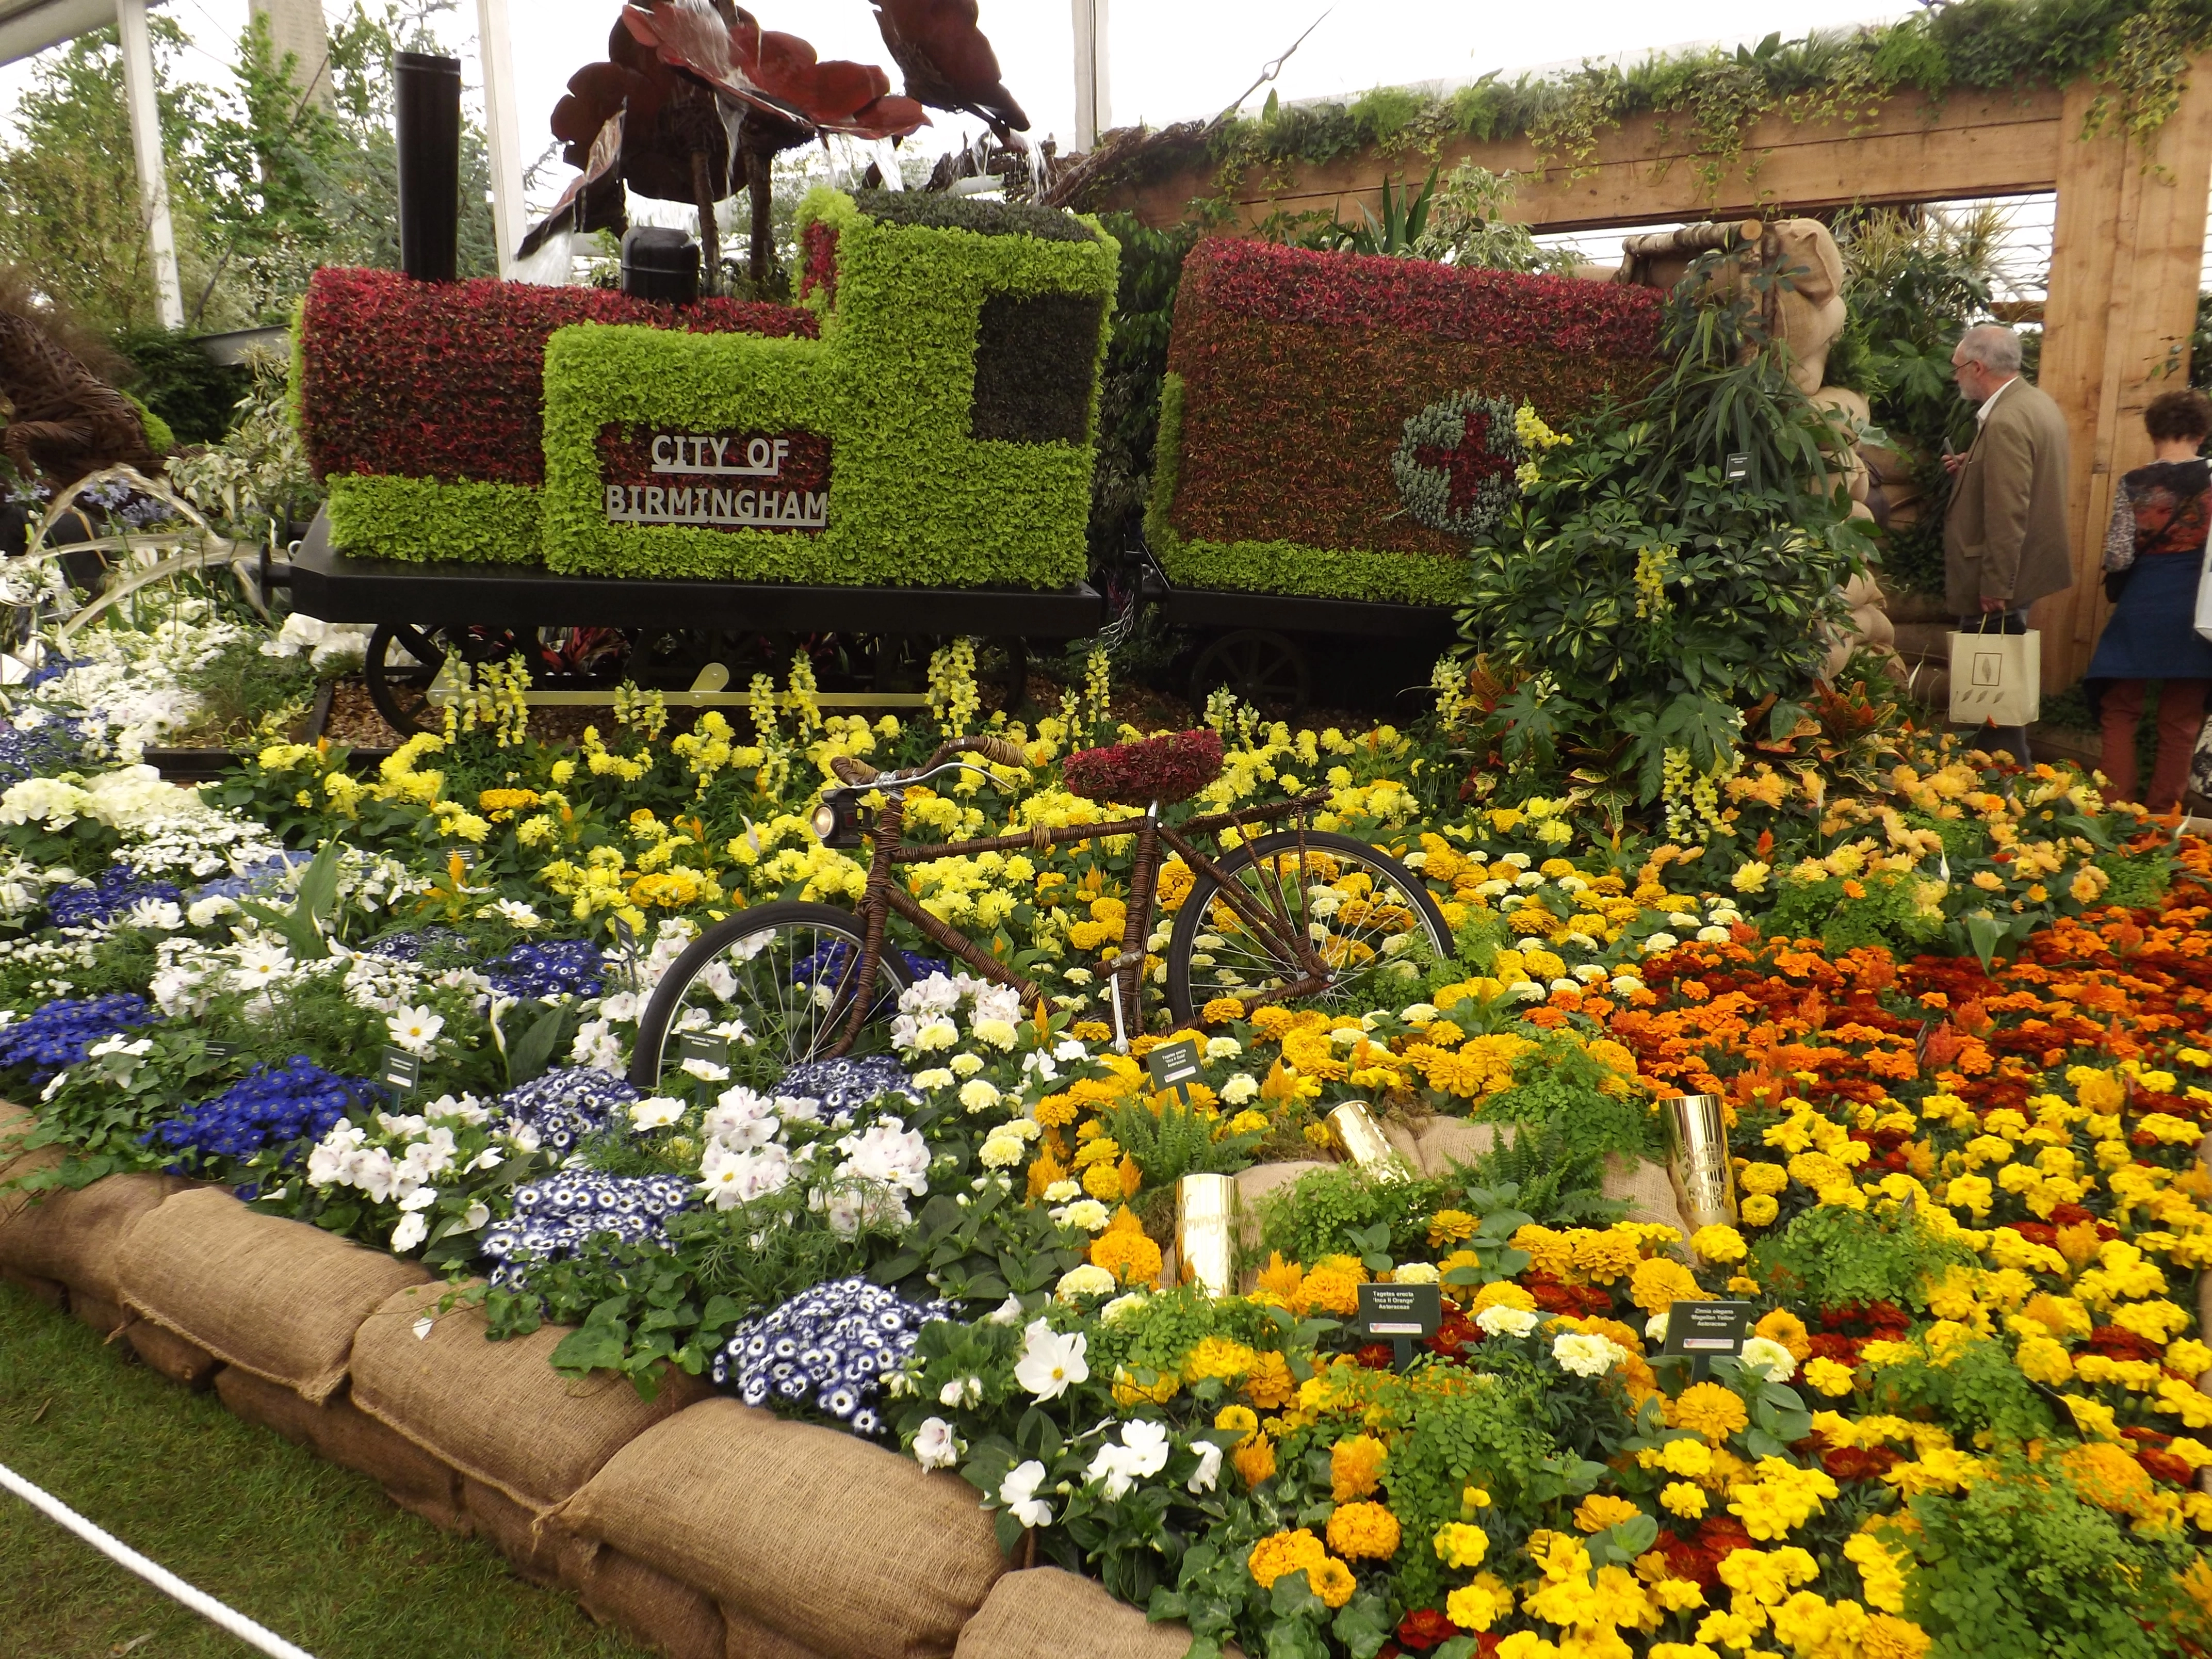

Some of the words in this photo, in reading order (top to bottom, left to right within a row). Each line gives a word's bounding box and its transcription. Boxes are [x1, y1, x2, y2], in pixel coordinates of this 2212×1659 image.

[652, 435, 729, 473] CITY
[747, 438, 790, 475] OF
[607, 485, 828, 526] BIRMINGHAM
